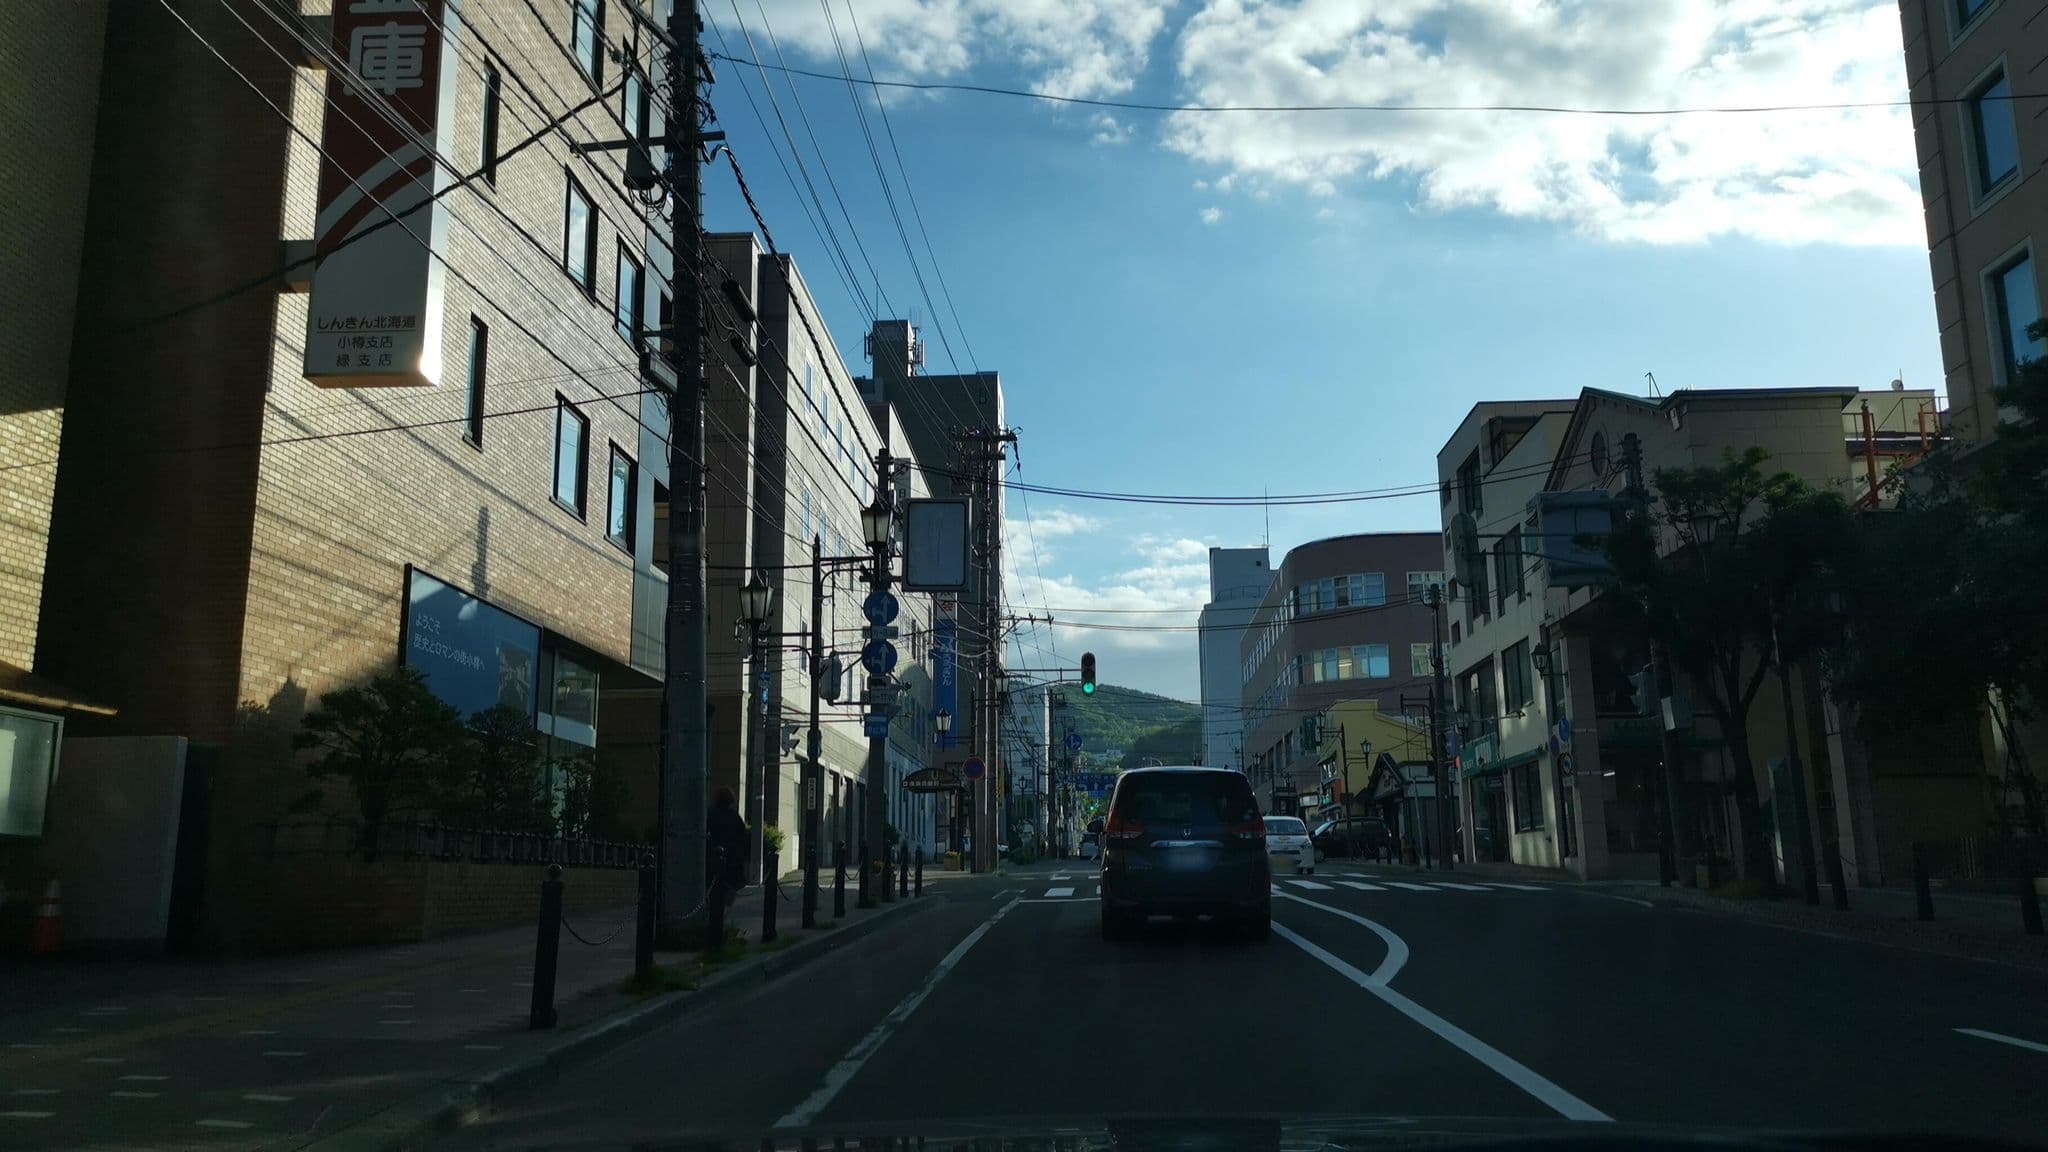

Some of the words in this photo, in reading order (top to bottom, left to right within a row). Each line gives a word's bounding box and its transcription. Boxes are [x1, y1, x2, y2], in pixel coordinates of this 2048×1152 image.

[343, 0, 429, 96] 庫
[317, 315, 416, 330] しんきん北海道
[337, 335, 393, 349] 小樽支店
[415, 612, 441, 636] ようこそ
